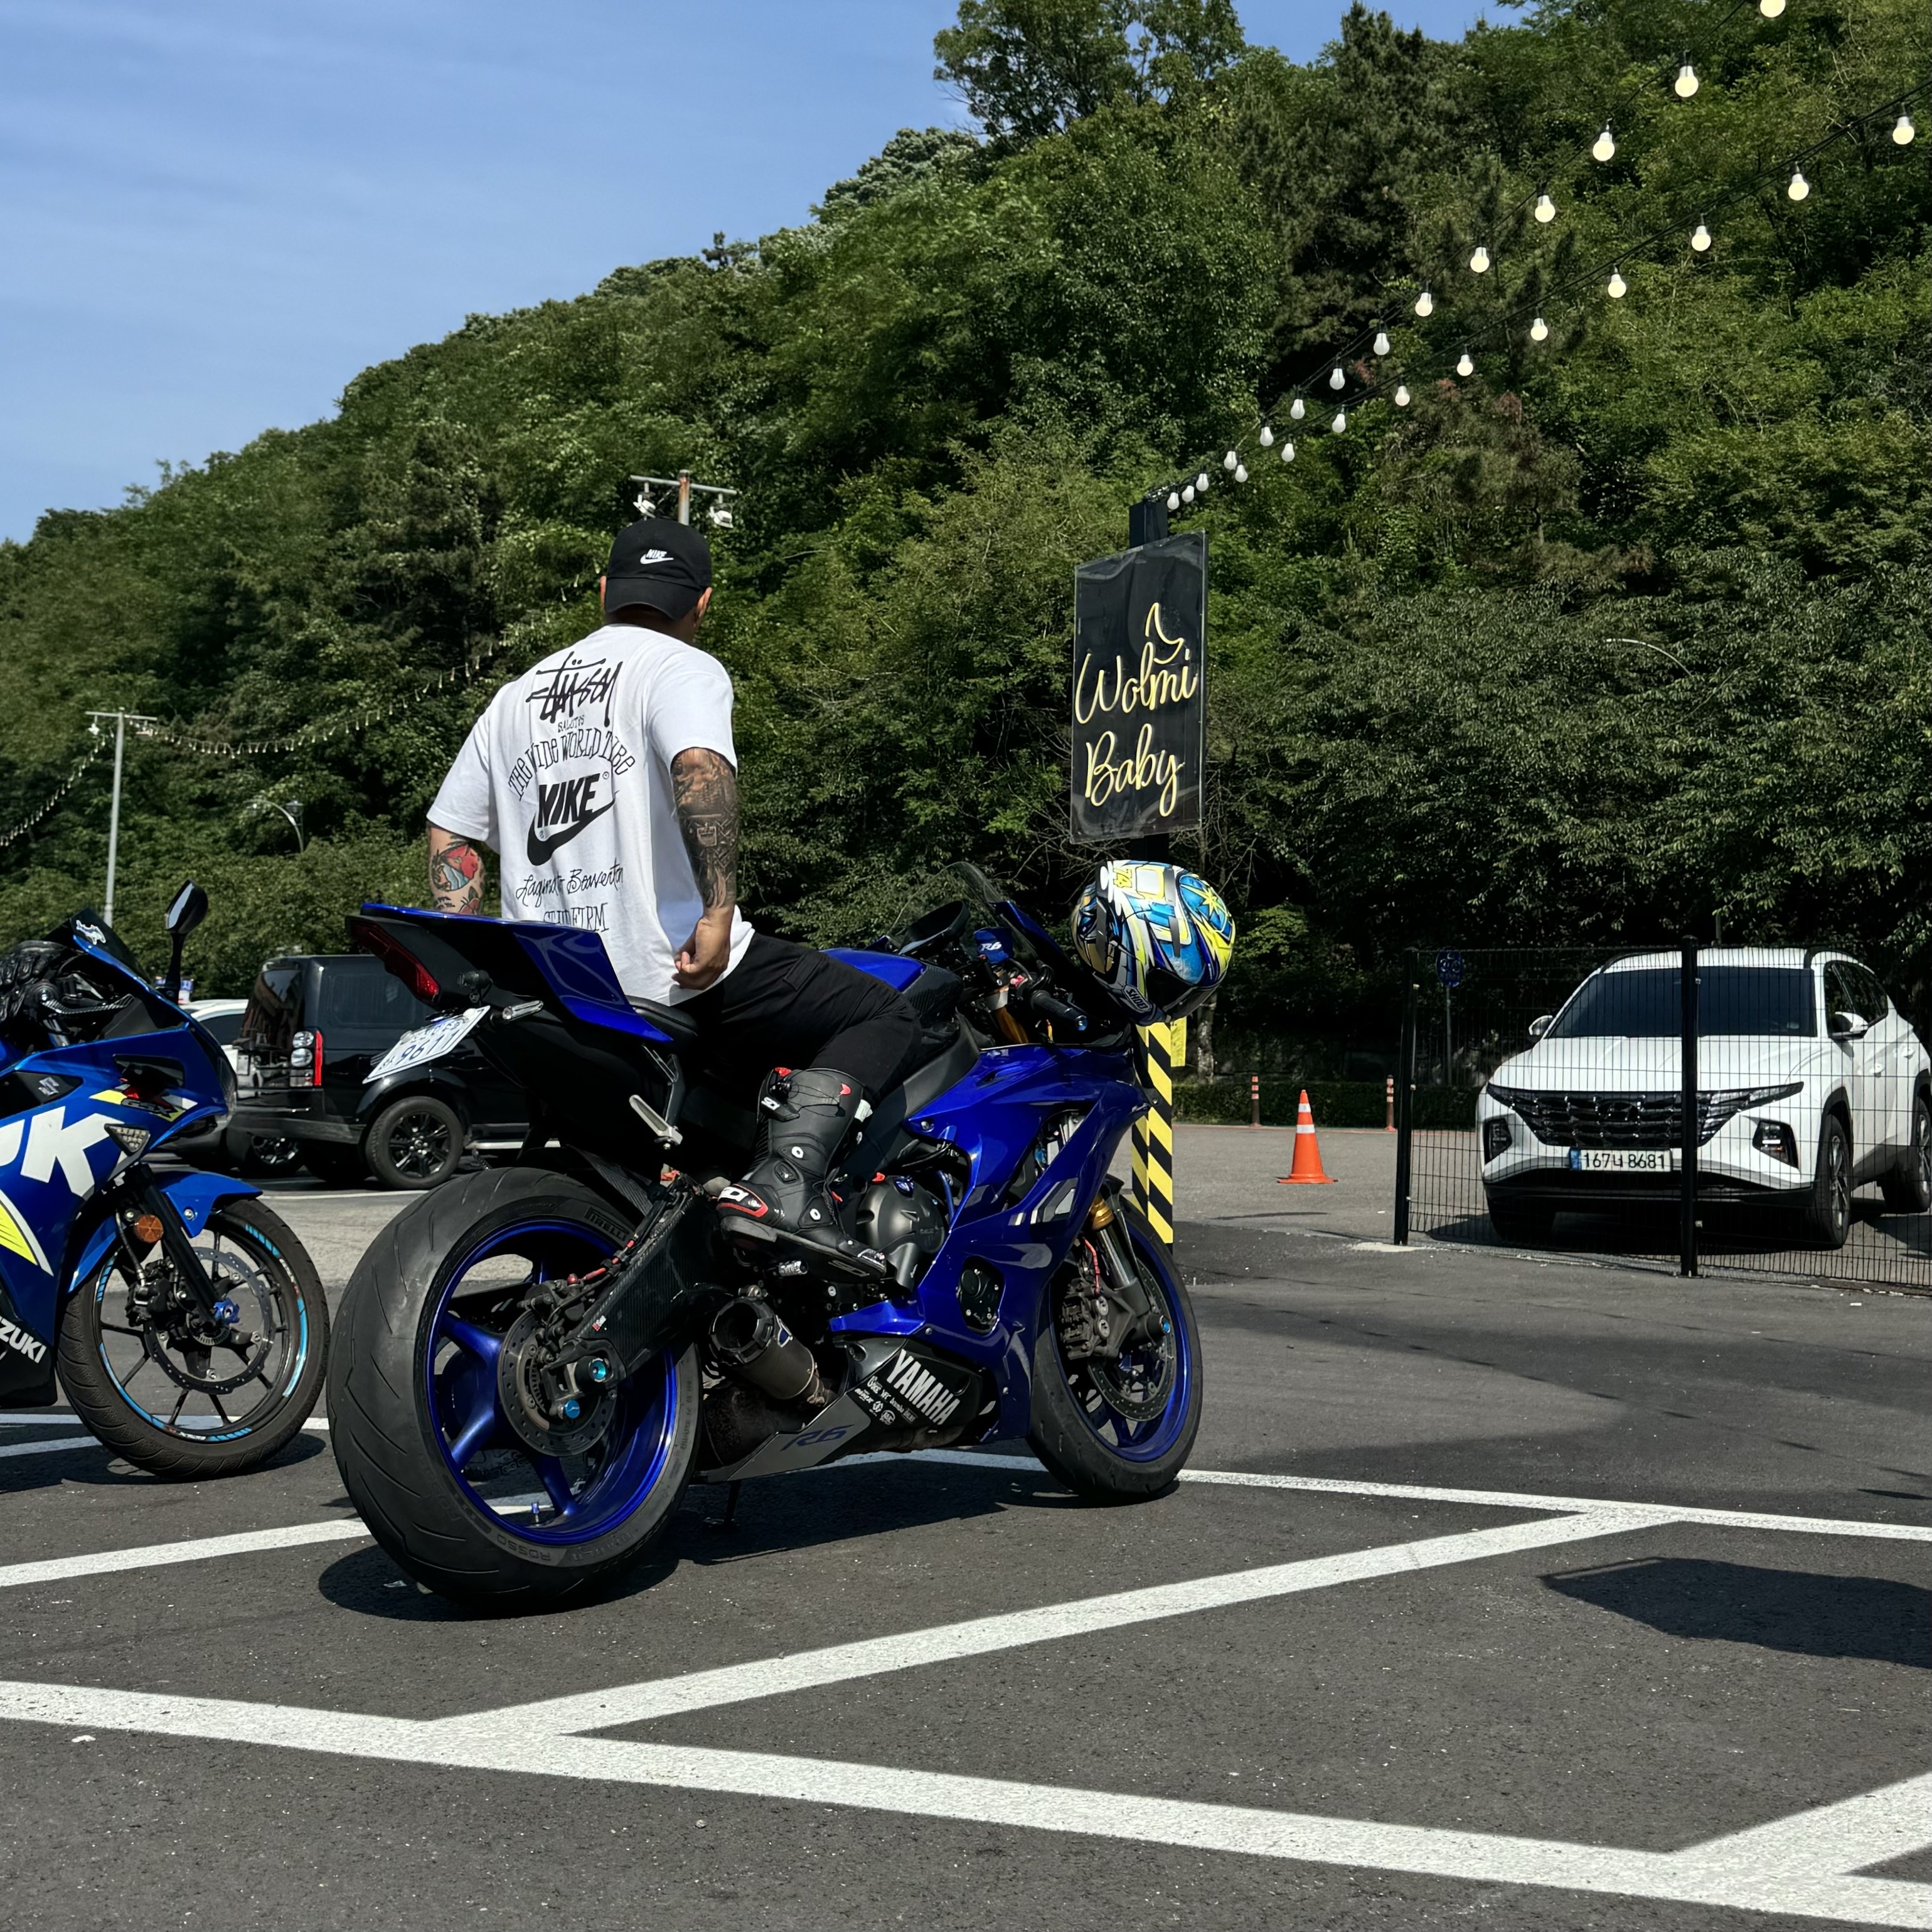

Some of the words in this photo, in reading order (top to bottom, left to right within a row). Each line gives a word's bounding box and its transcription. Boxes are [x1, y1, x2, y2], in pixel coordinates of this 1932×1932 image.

[645, 548, 668, 559] NIKE
[1074, 641, 1198, 724] Wolmi
[560, 727, 602, 762] WORLD
[1084, 723, 1185, 817] Baby
[537, 772, 600, 829] NIKE
[980, 941, 1003, 951] R6
[887, 1348, 961, 1426] YAMAHA
[496, 1533, 551, 1561] ROSSO
